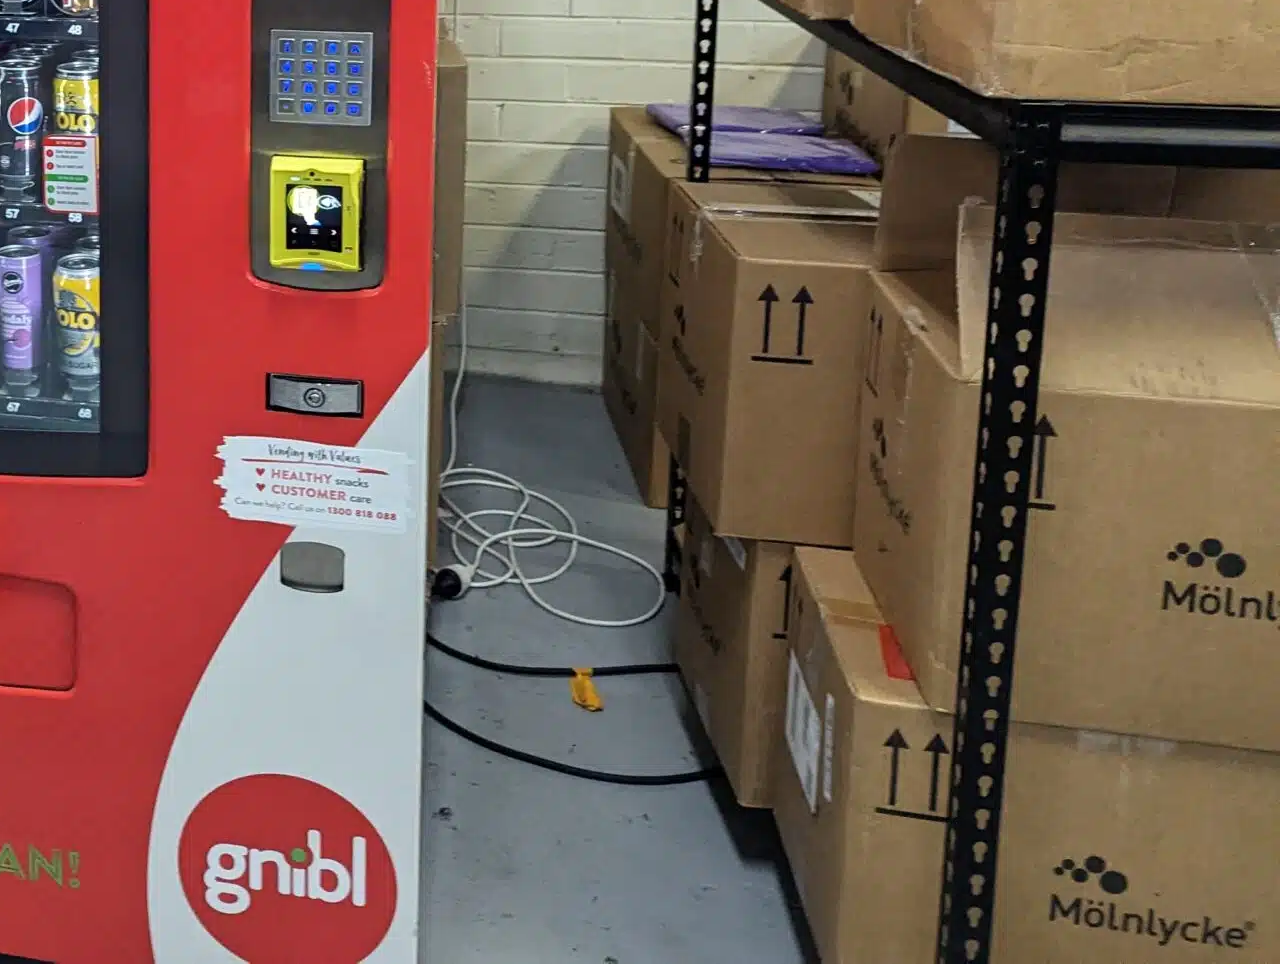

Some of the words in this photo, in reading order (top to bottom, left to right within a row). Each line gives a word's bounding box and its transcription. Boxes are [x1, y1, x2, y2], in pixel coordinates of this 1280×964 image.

[6, 23, 19, 34] 47
[68, 24, 81, 35] 48
[5, 208, 20, 219] 57
[7, 402, 20, 413] 67
[268, 444, 305, 462] Vending
[307, 449, 326, 461] with
[328, 451, 361, 464] Values
[271, 468, 332, 486] HEALTHY
[335, 477, 369, 488] snacks
[271, 485, 346, 501] CUSTOMER
[349, 496, 372, 504] care
[234, 497, 251, 505] Can
[264, 499, 286, 511] help?
[288, 503, 304, 511] Call
[327, 506, 352, 516] 1300
[1161, 579, 1280, 630] Mölnl
[203, 829, 367, 915] gnibl
